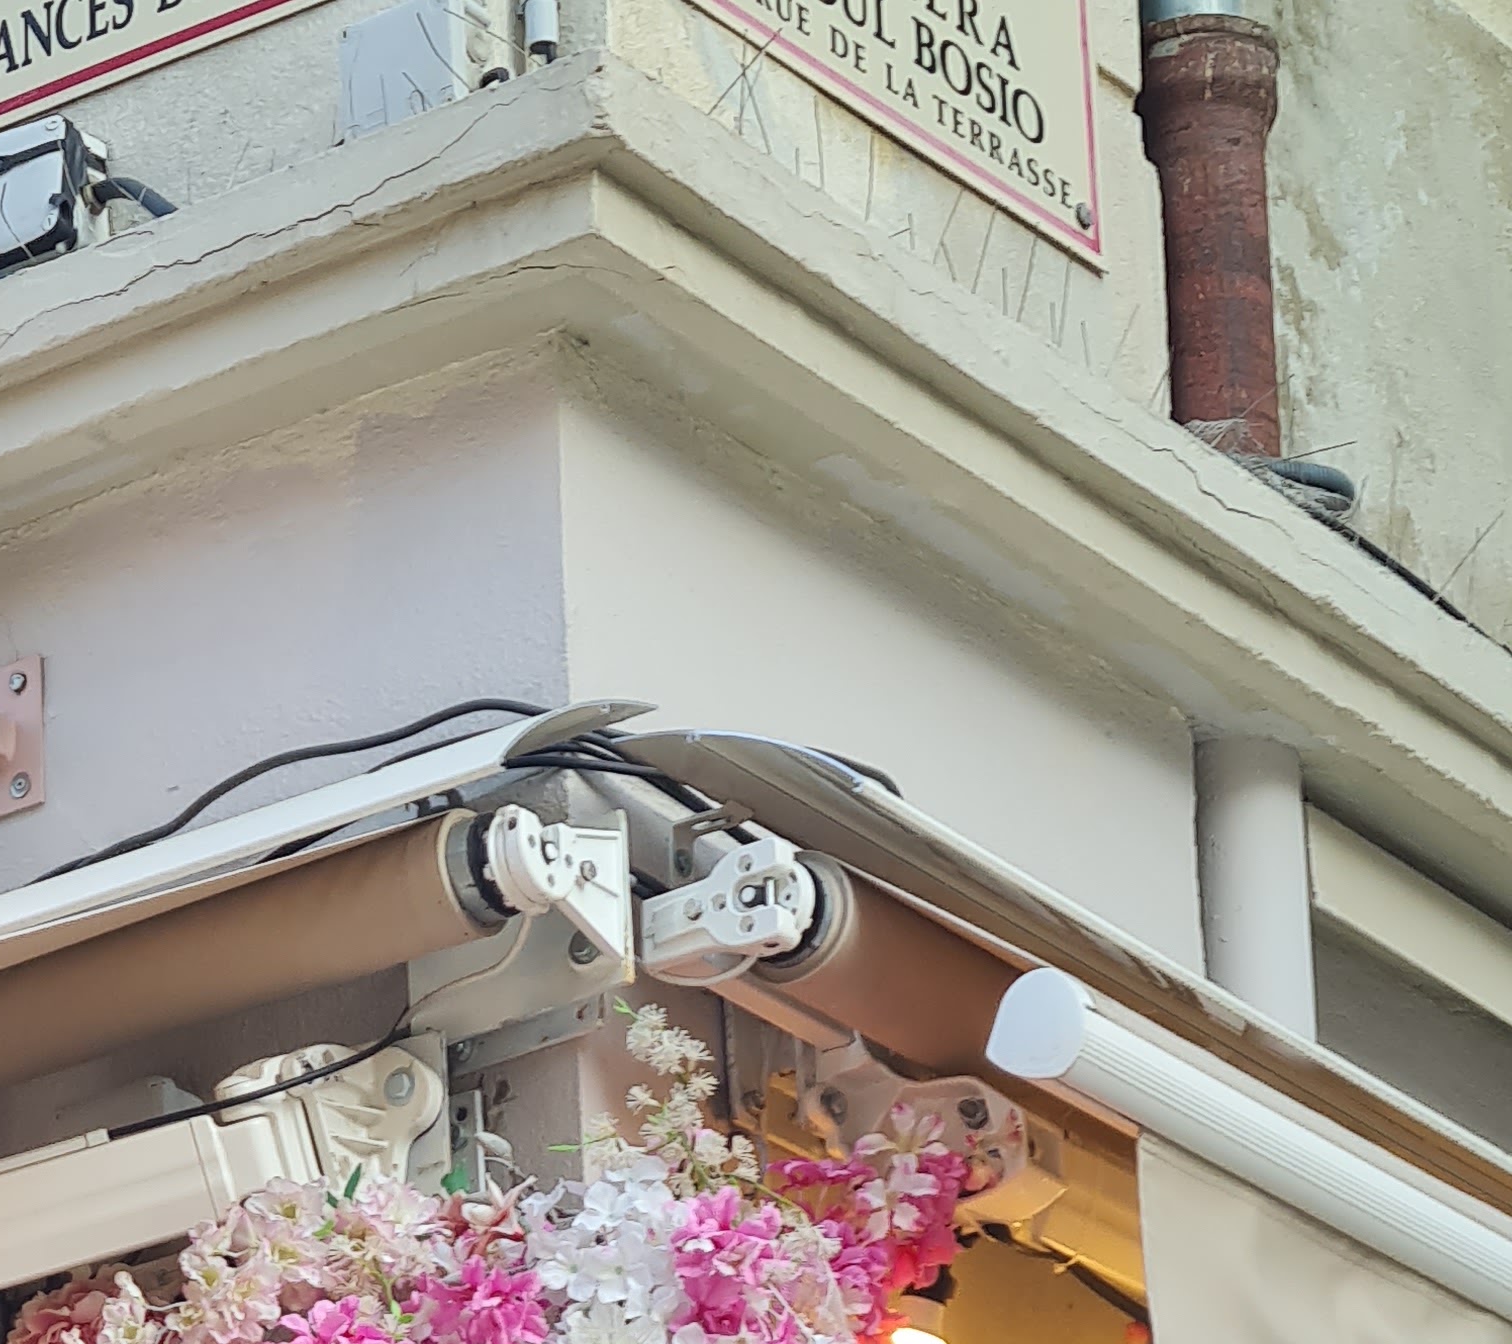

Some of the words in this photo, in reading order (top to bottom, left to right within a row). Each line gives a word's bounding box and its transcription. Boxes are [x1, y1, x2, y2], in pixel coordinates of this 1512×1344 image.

[821, 0, 896, 49] UL
[912, 16, 1044, 144] BOSIO
[829, 24, 868, 74] DE
[885, 62, 920, 109] LA
[932, 94, 1073, 209] TERRASSE
